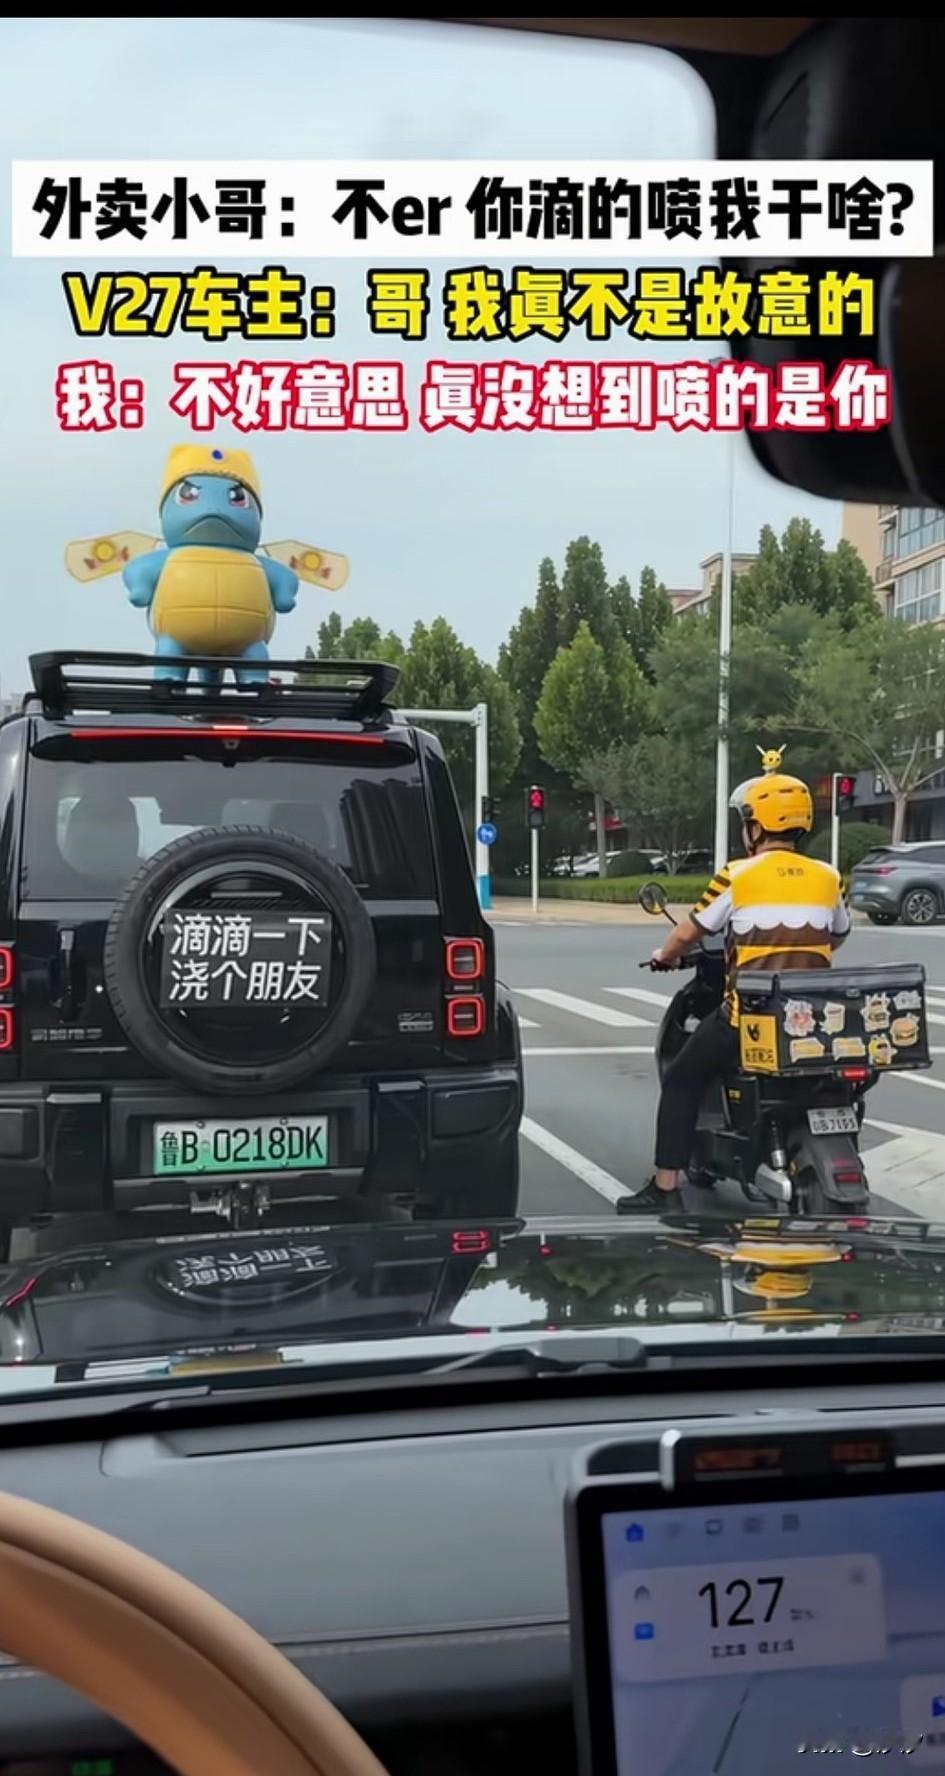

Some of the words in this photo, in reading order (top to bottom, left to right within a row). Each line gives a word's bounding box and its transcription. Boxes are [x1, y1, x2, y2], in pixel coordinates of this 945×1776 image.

[170, 913, 325, 957] 滴滴一下
[169, 959, 322, 1001] 浇个朋友
[699, 1576, 785, 1629] 127
